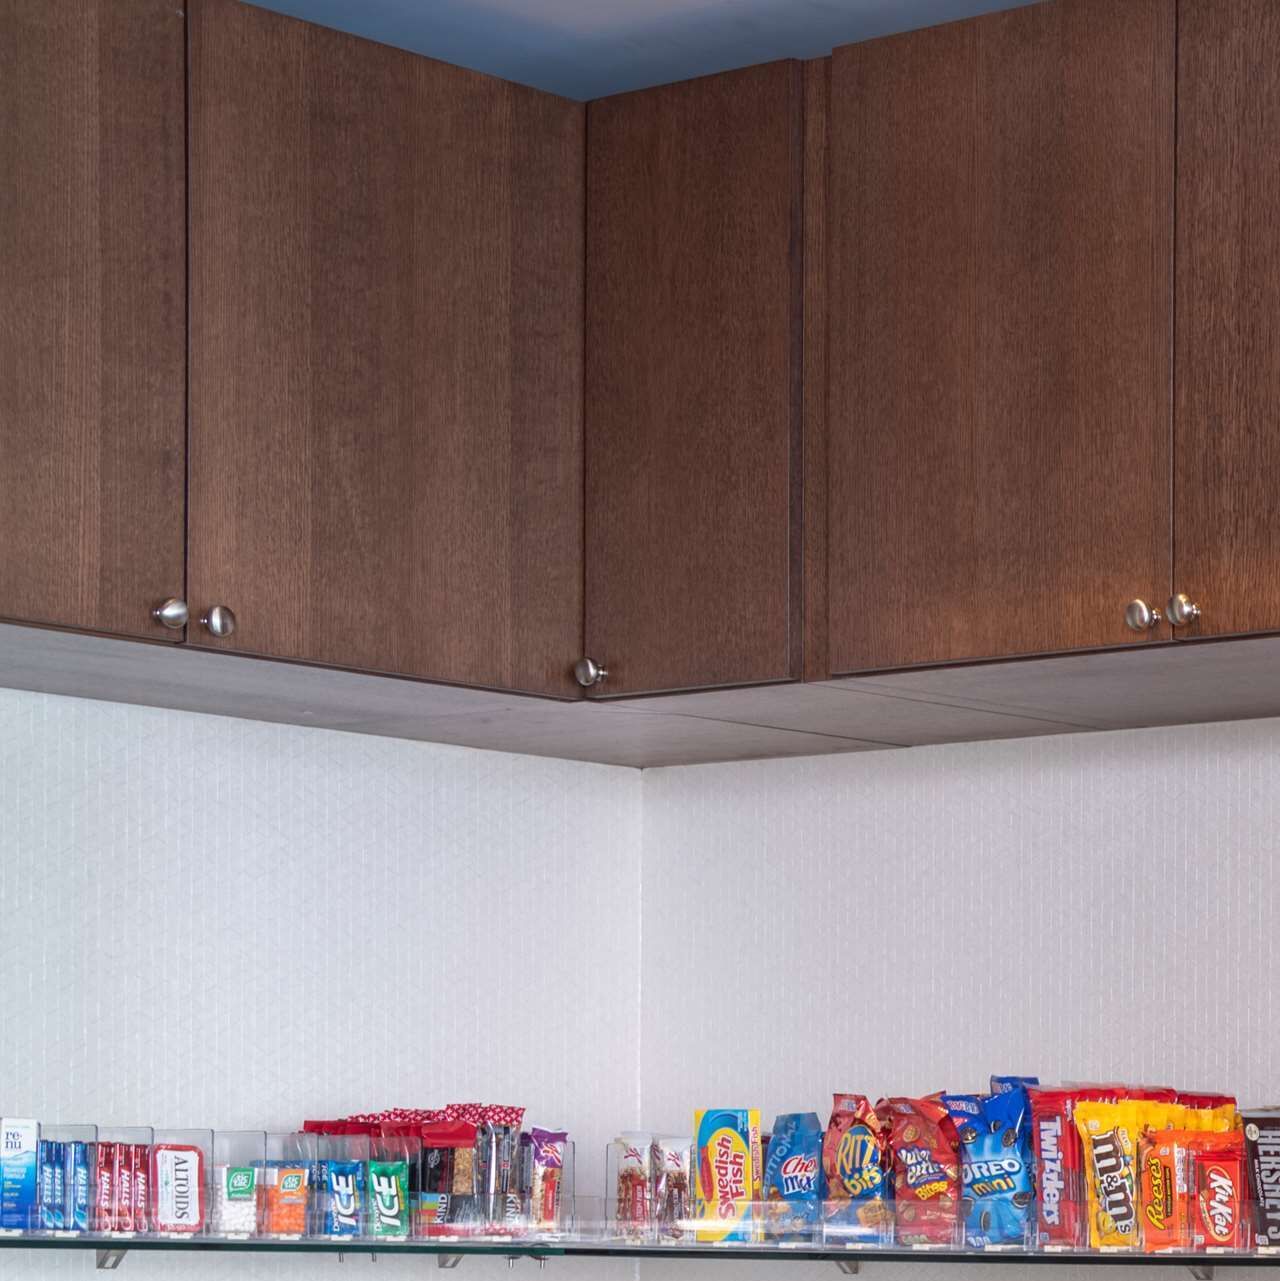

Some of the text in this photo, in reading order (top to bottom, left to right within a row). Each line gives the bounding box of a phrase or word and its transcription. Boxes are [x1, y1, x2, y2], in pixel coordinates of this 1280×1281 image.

[5, 1139, 22, 1149] nu
[837, 1132, 881, 1176] RITZ
[43, 1167, 53, 1204] HALLS
[76, 1167, 88, 1205] HALLS
[100, 1171, 110, 1208] HALLS
[120, 1168, 130, 1207] HALLS
[174, 1155, 190, 1219] ALTOIDS
[716, 1135, 737, 1220] Swedish
[729, 1152, 745, 1200] Fish
[783, 1176, 816, 1195] Mix
[845, 1166, 882, 1196] bits
[962, 1159, 1021, 1183] OREO
[971, 1174, 1016, 1196] mini
[1040, 1116, 1064, 1225] Twizzlers
[136, 1171, 148, 1209] HALLS
[331, 1172, 357, 1226] ICE
[371, 1172, 401, 1227] ICE
[433, 1193, 448, 1224] KIND
[915, 1180, 948, 1200] Bites
[1146, 1157, 1167, 1231] Reese's
